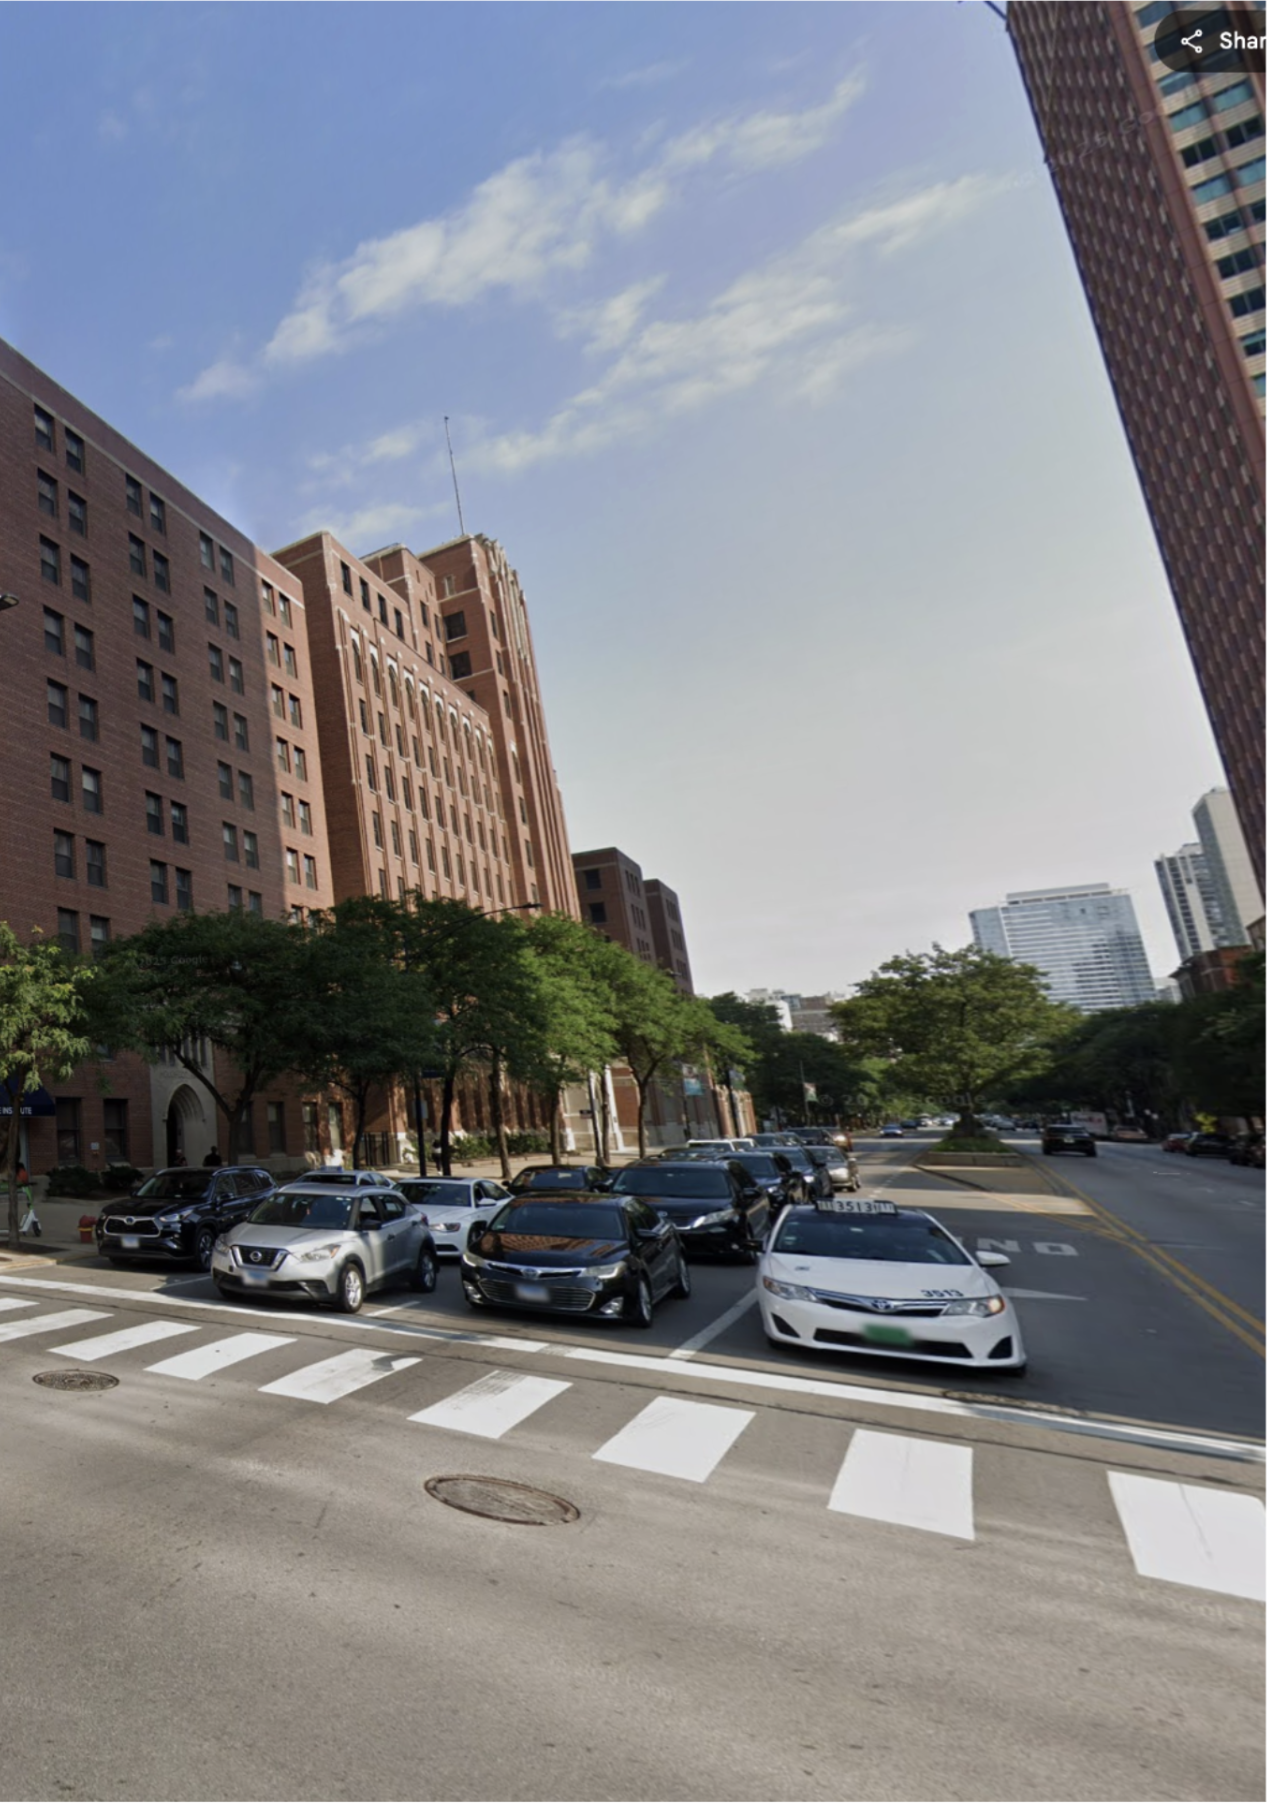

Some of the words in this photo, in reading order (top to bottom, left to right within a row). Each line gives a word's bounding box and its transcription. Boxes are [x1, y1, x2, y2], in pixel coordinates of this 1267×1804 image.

[2, 1106, 32, 1115] INSUTE
[836, 1201, 873, 1213] 3513
[921, 1289, 964, 1298] 3513
